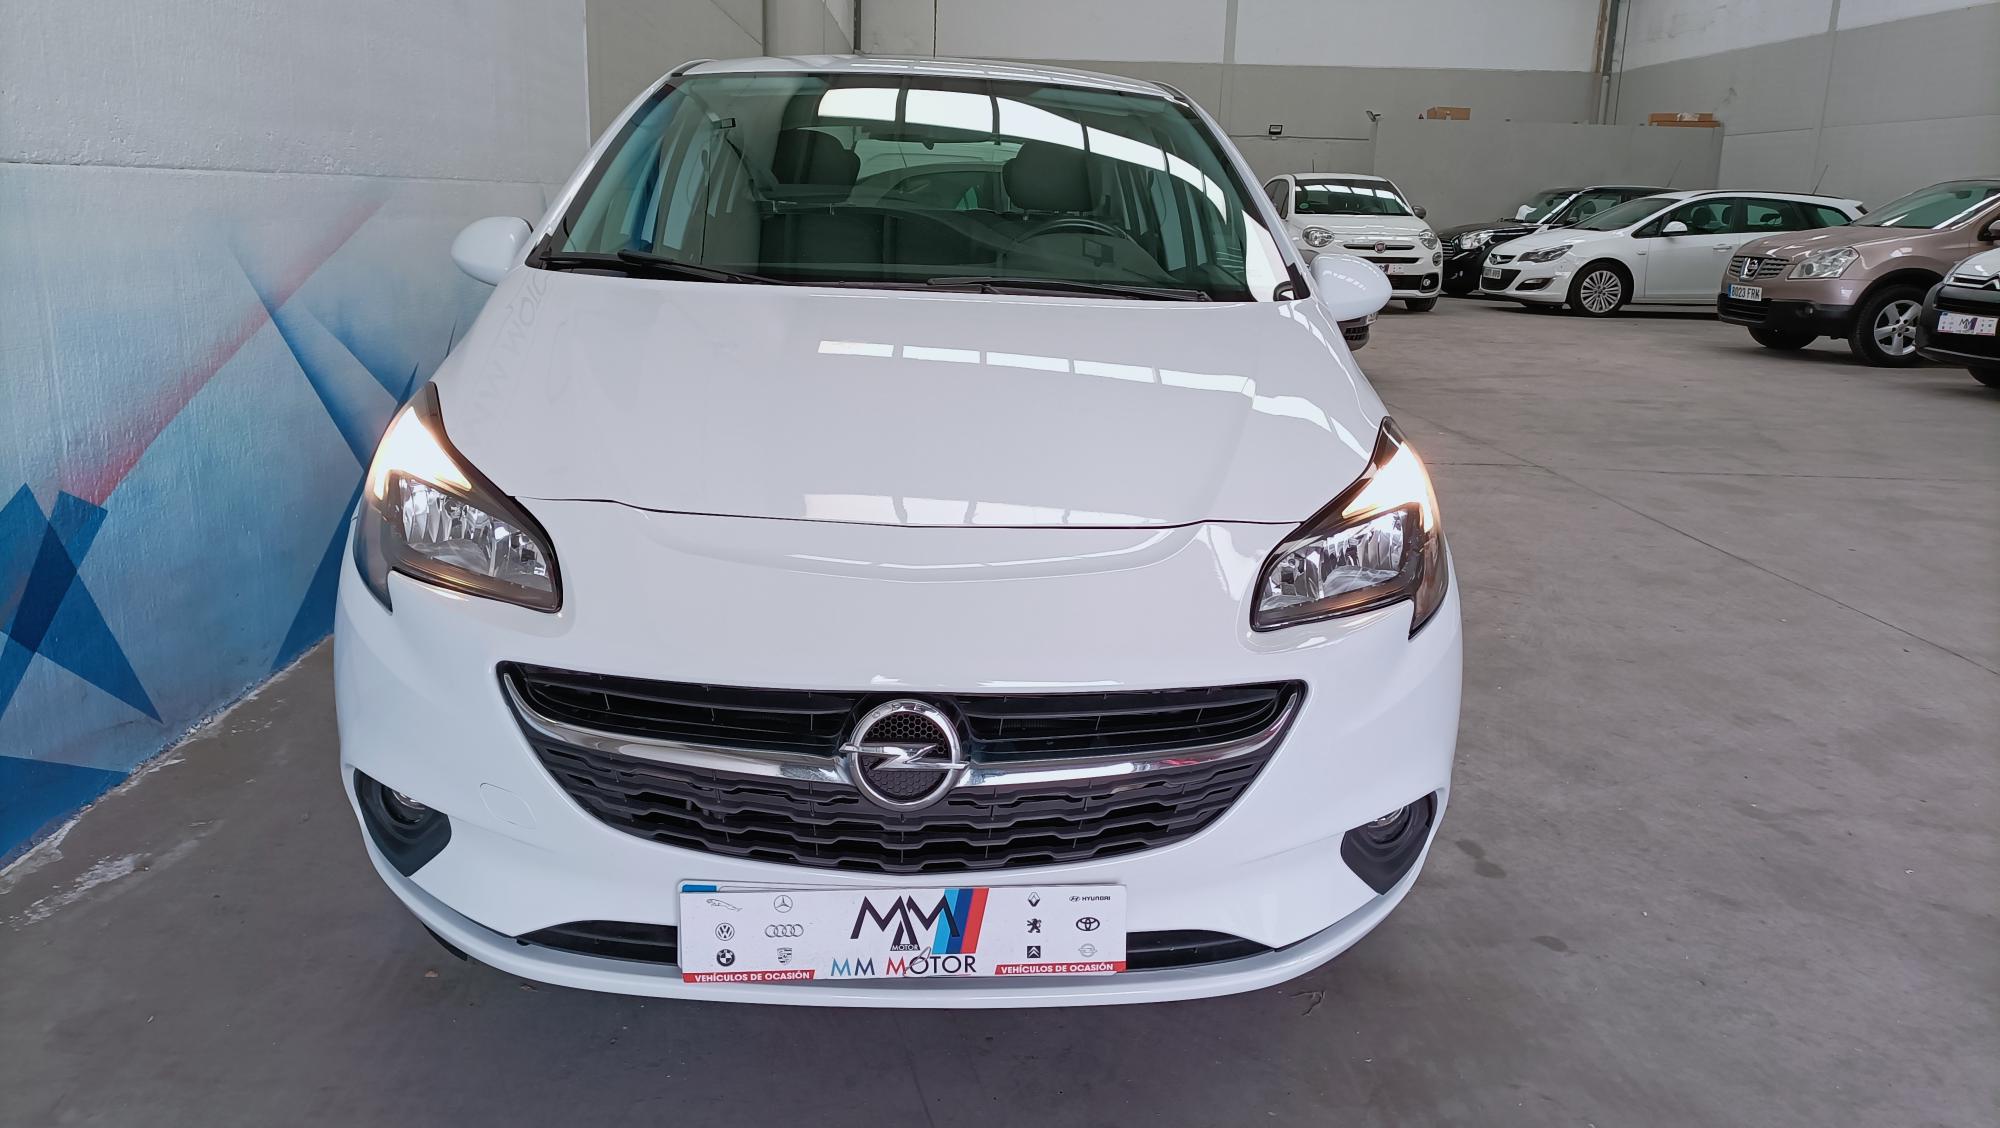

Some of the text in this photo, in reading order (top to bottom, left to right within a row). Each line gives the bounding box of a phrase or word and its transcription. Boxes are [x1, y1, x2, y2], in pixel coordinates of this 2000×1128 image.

[831, 955, 977, 976] MM MOTOR
[1000, 964, 1053, 974] VEHÍCULOS
[1069, 963, 1113, 972] OCASIÓN
[694, 970, 810, 983] VEHÍCULOS DE OCASIÓN
